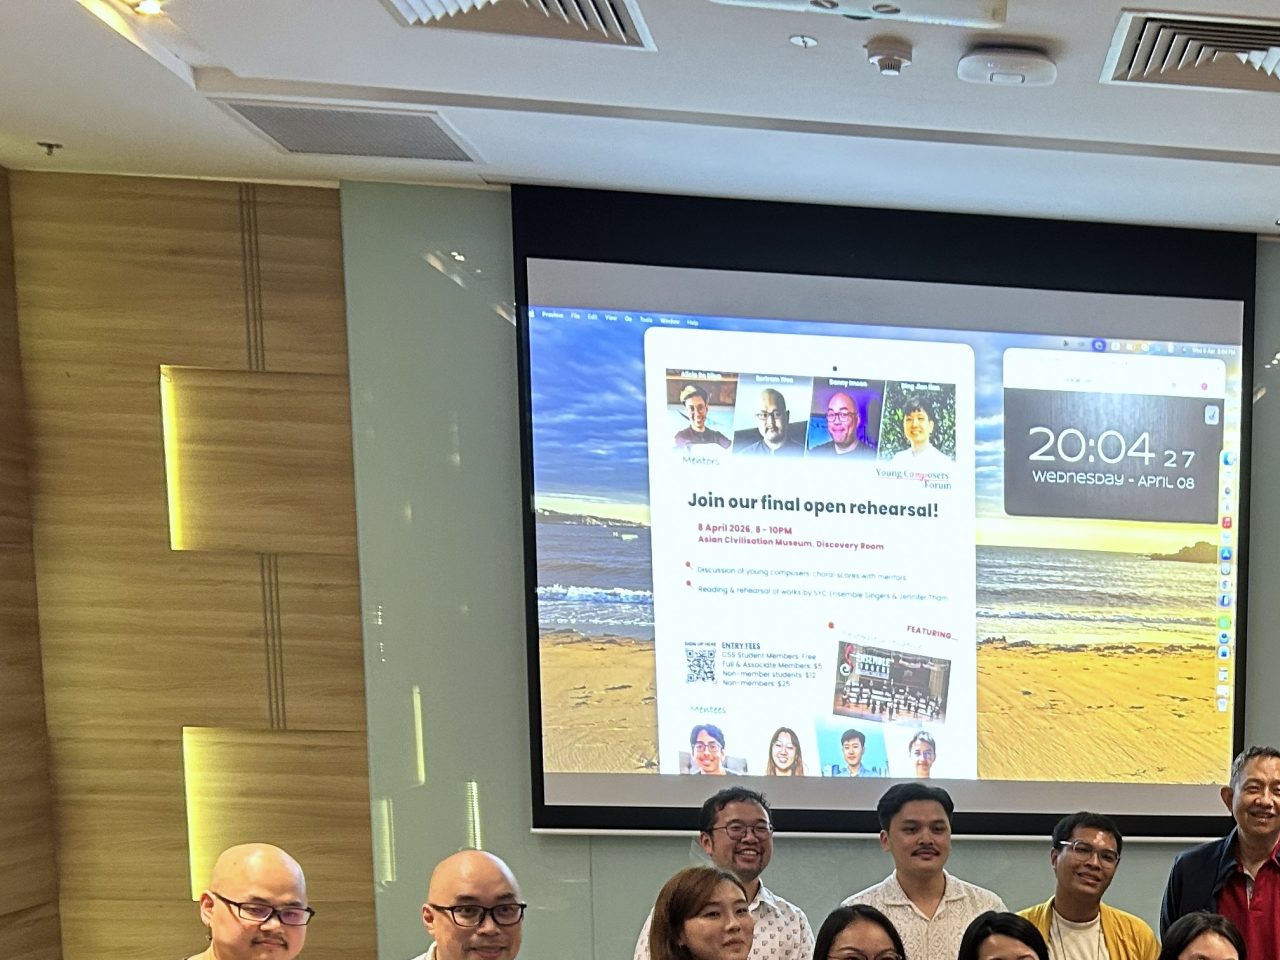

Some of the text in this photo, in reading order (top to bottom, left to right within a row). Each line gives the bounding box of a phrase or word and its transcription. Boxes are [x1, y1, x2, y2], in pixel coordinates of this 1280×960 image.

[1029, 426, 1196, 468] 20:04 27
[876, 468, 949, 481] Young Composers
[924, 480, 951, 489] Forum
[1176, 477, 1195, 489] 08
[688, 491, 938, 518] Join our final open rehearsal!
[698, 523, 703, 531] 8
[705, 523, 727, 533] April
[769, 526, 792, 534] 10PM
[725, 536, 773, 545] Civilisation
[816, 541, 858, 551] Discovery
[746, 568, 768, 577] young
[699, 586, 728, 595] Reading
